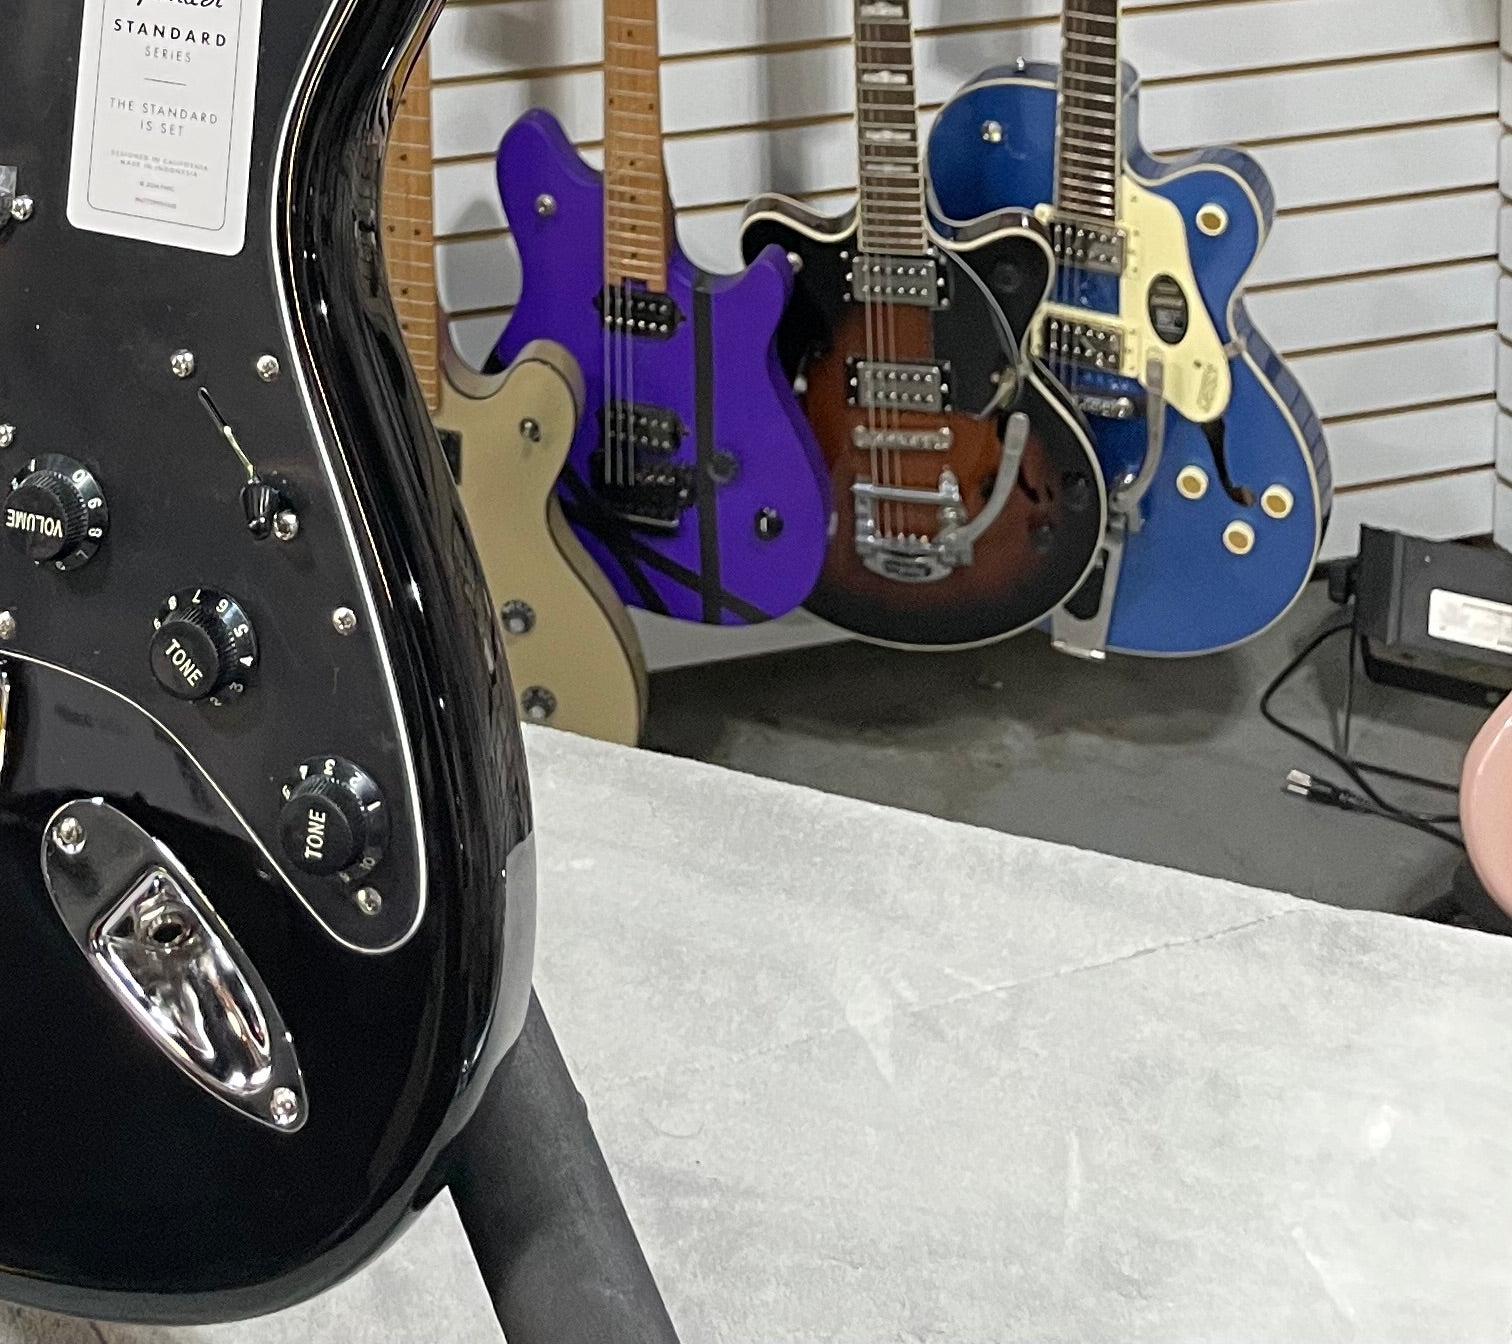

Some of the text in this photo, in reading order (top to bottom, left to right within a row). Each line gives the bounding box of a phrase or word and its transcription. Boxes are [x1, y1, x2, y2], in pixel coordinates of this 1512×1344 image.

[114, 18, 226, 47] STANDARD
[144, 45, 192, 63] SERIES
[110, 97, 218, 124] THE STANDARD
[140, 120, 184, 137] IS SET
[5, 508, 63, 538] VOLUME
[88, 528, 103, 538] 8
[192, 589, 201, 604] 7
[233, 624, 248, 637] 5
[165, 638, 204, 687] TONE
[240, 655, 253, 667] 4
[229, 681, 244, 693] 3
[209, 696, 223, 707] 2
[324, 758, 336, 776] 3
[304, 808, 327, 860] TONE
